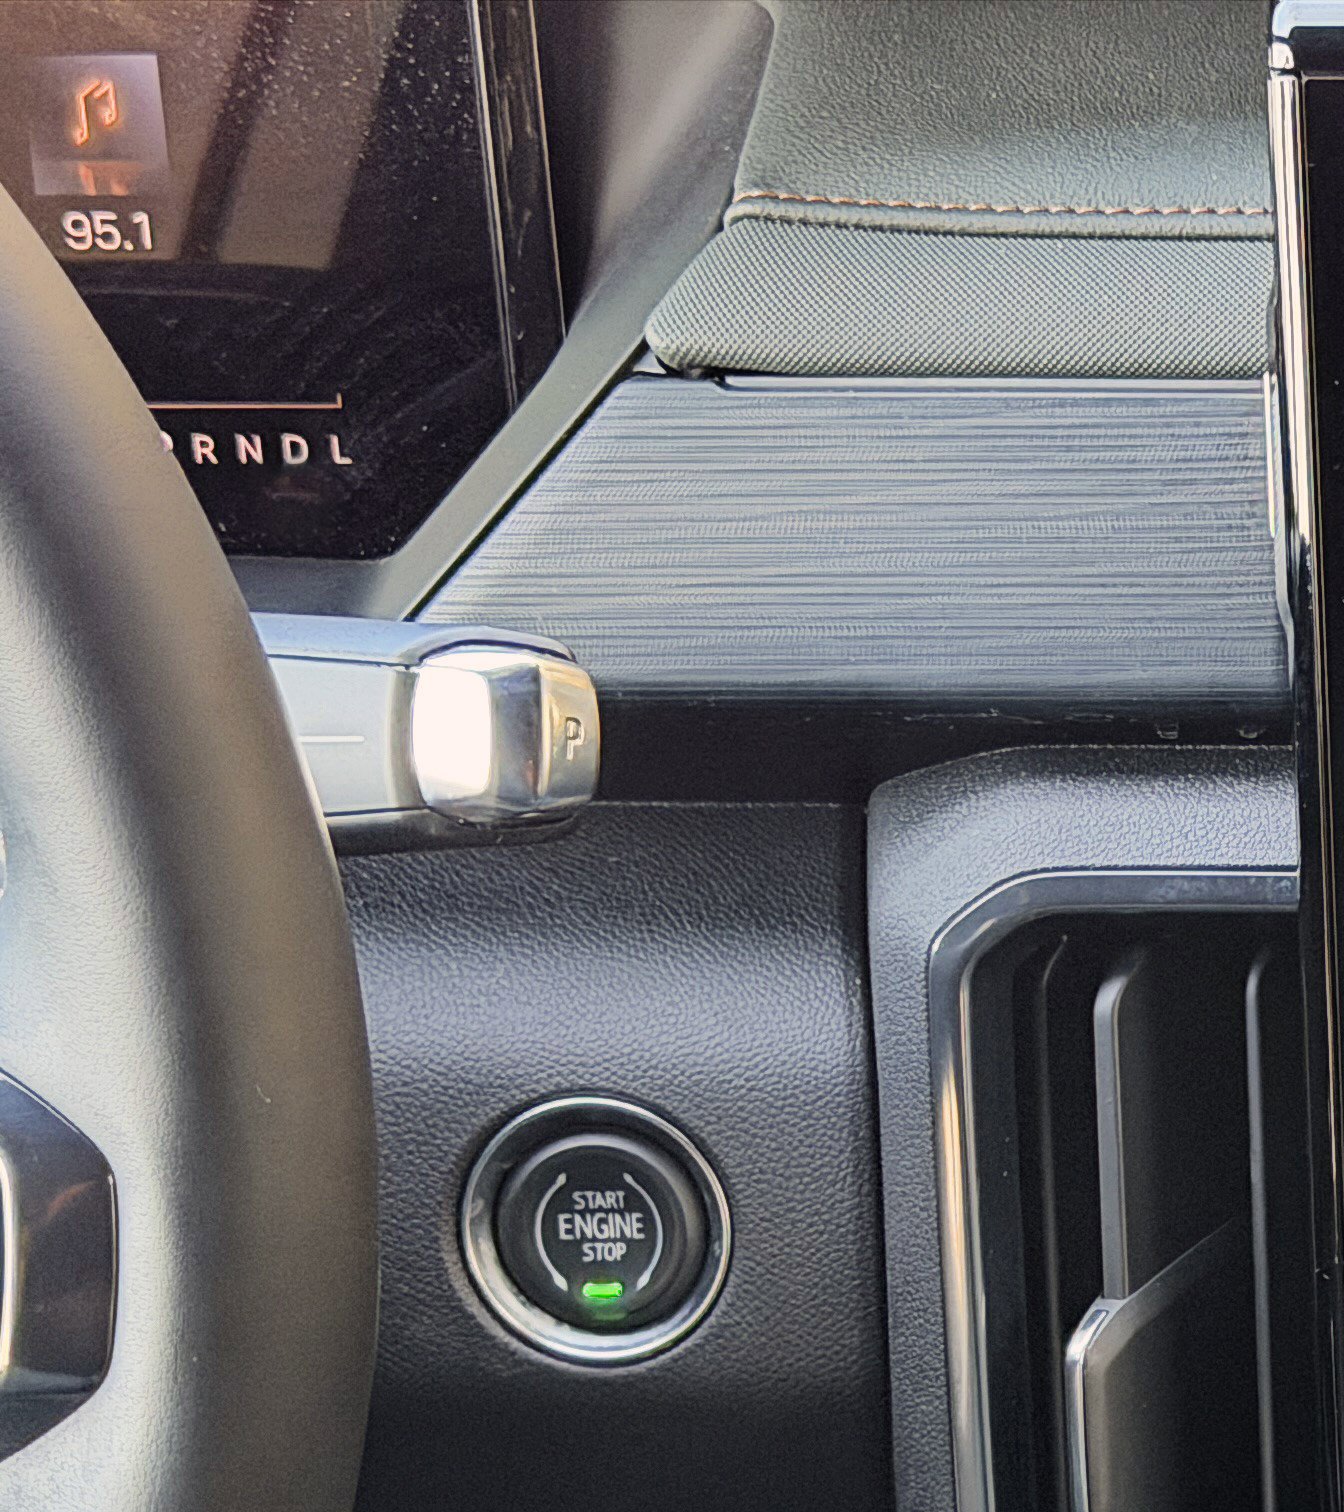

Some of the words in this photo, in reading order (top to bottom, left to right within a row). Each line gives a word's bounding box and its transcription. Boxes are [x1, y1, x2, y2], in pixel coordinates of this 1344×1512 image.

[62, 210, 154, 251] 95.1
[564, 716, 584, 761] P
[571, 1190, 625, 1210] START
[557, 1212, 646, 1240] ENGINE
[582, 1242, 627, 1262] STOP
